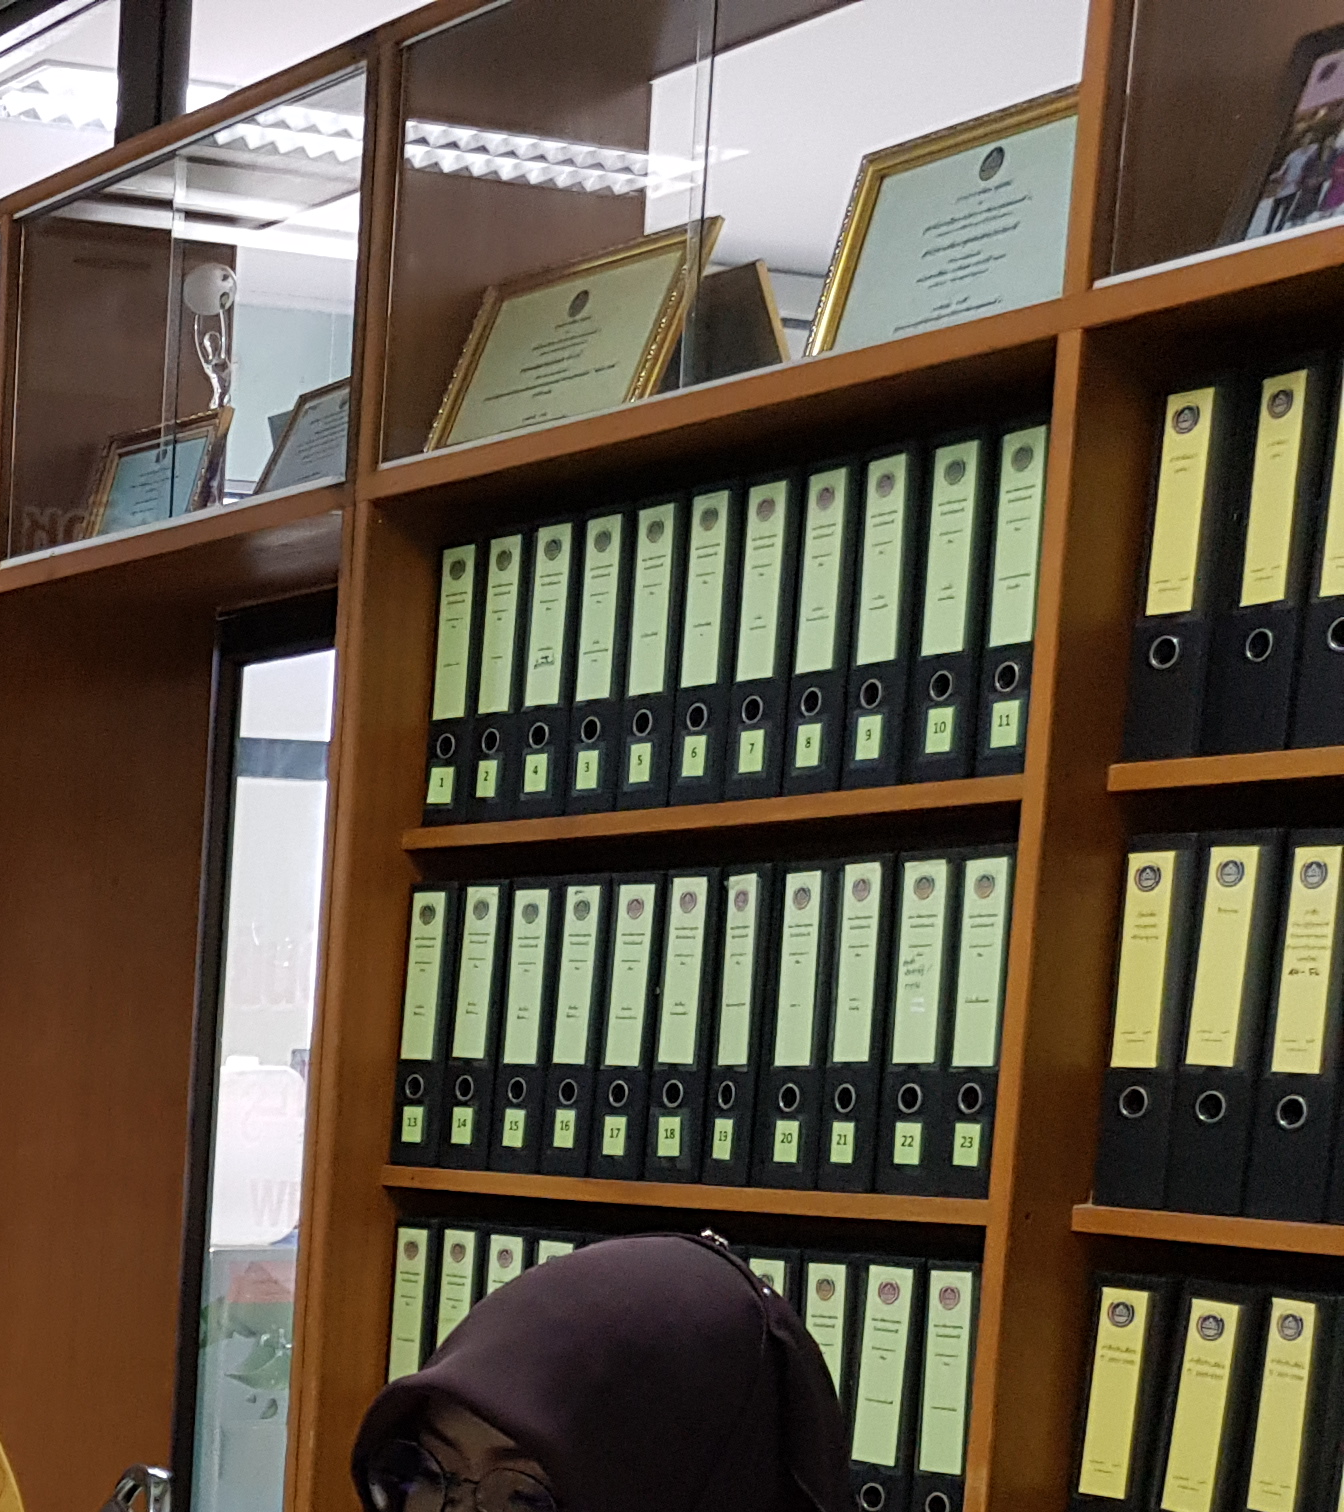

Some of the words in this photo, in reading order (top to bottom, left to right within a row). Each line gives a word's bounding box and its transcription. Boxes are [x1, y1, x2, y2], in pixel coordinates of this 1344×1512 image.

[932, 720, 947, 735] 10
[997, 714, 1011, 728] 11
[406, 1116, 418, 1129] 13
[456, 1117, 468, 1130] 14
[508, 1119, 520, 1132] 15
[559, 1119, 571, 1132] 16
[608, 1127, 622, 1140] 17
[663, 1128, 676, 1141] 18
[717, 1130, 728, 1143] 19
[780, 1132, 793, 1145] 20
[835, 1133, 848, 1146] 21
[899, 1134, 914, 1148] 22
[959, 1135, 974, 1149] 23
